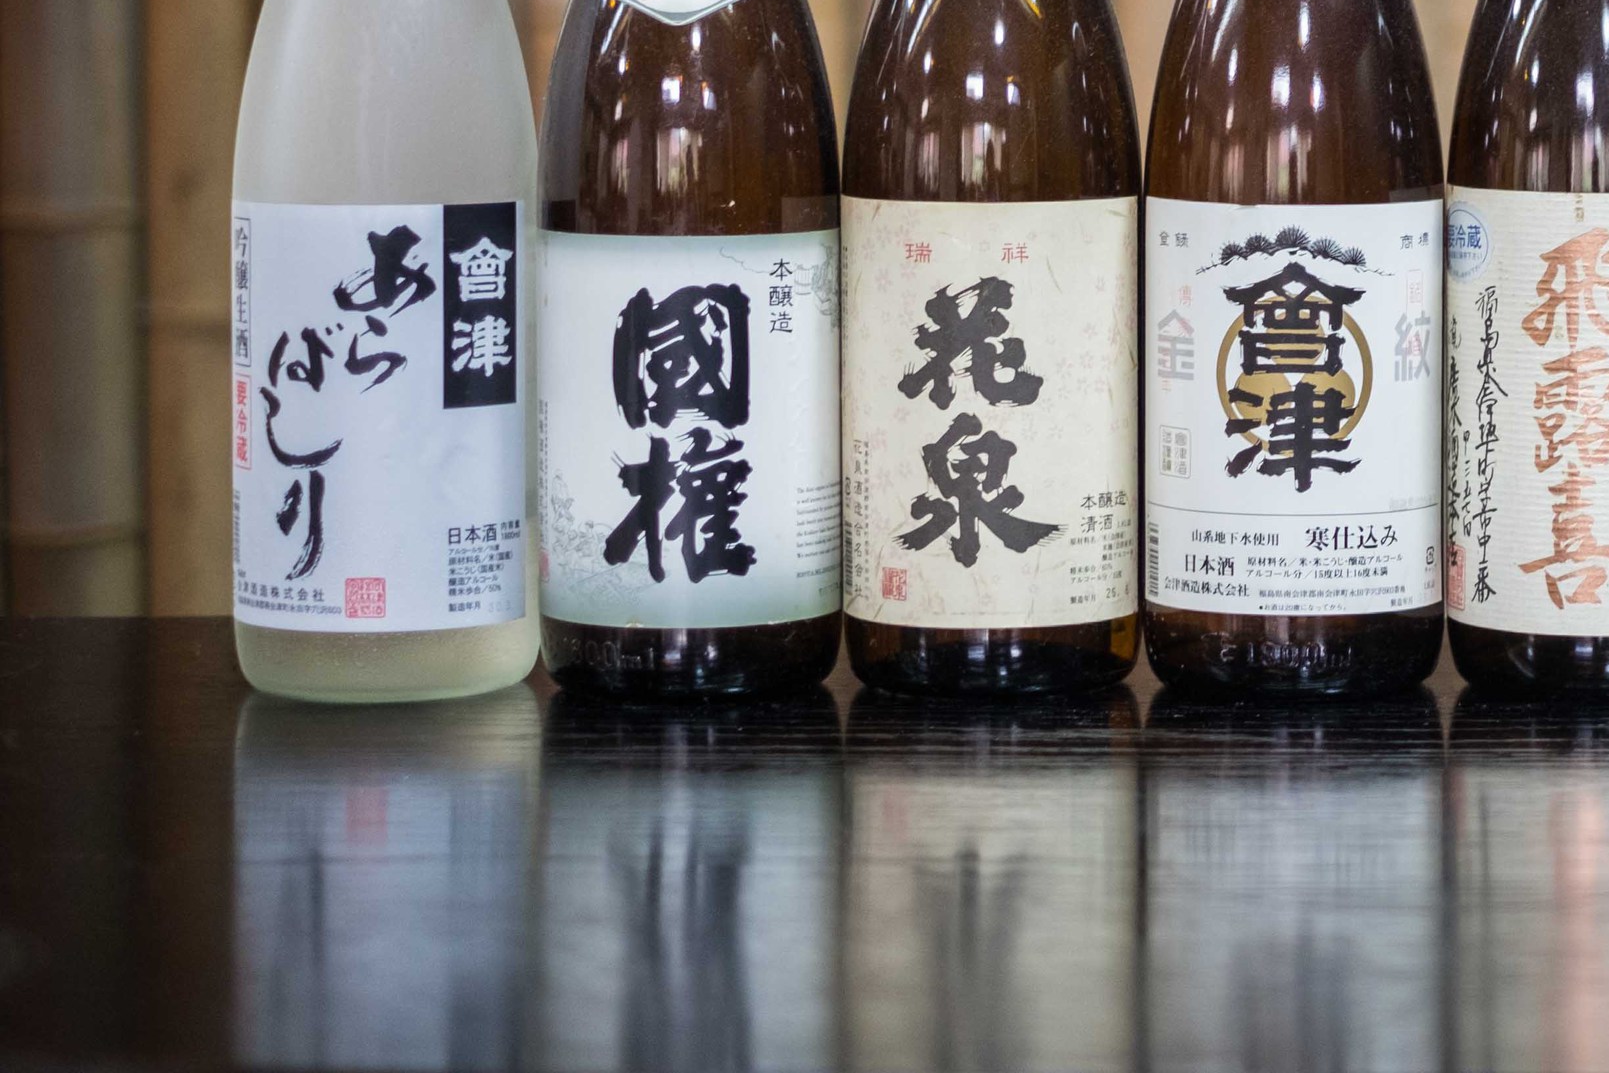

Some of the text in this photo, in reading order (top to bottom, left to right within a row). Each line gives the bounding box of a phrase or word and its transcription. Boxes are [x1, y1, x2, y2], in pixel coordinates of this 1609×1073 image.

[905, 242, 1029, 263] 瑞祥
[449, 237, 513, 378] 會津
[769, 258, 793, 334] 本醸造
[1157, 308, 1195, 381] 金
[1394, 312, 1431, 382] 紋
[1223, 261, 1366, 493] 會津
[236, 381, 248, 461] 要冷蔵
[892, 276, 1068, 568] 花泉
[1081, 491, 1126, 510] 本醸造
[448, 524, 497, 545] 日本酒
[1081, 514, 1113, 533] 清酒
[1192, 524, 1398, 551] 山系地下水使用 寒仕込み
[1185, 554, 1234, 576] 日本酒
[1164, 576, 1249, 597] 会津酒造株式会社
